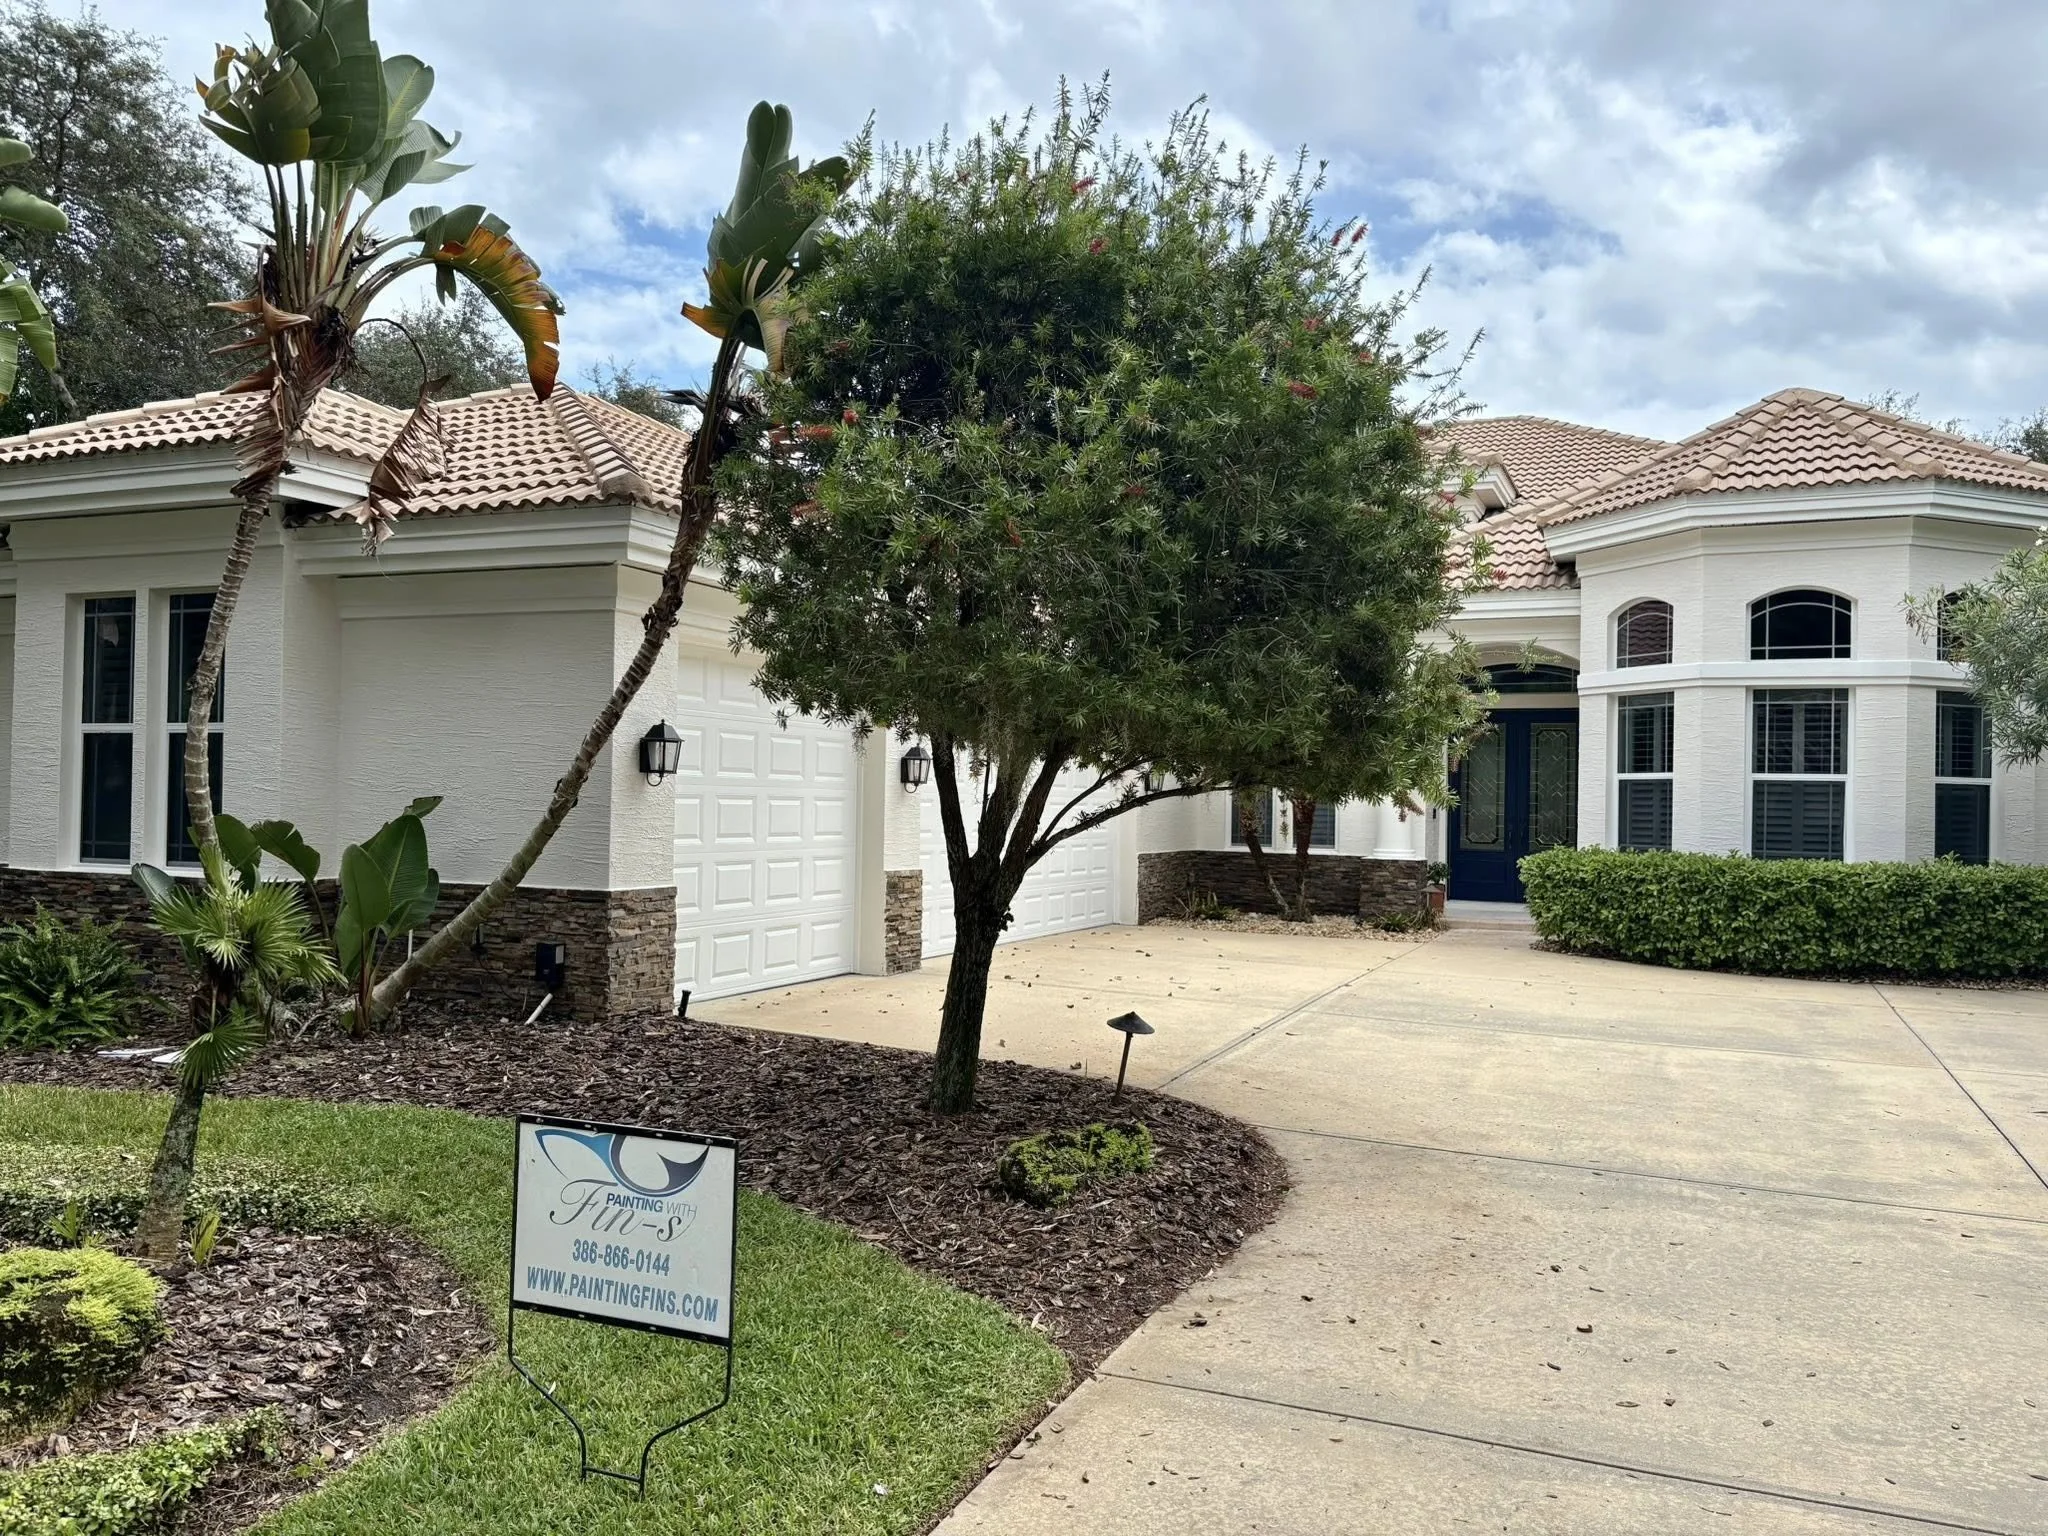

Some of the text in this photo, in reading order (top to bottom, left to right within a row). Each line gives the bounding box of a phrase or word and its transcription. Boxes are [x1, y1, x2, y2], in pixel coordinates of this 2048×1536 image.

[606, 1192, 698, 1218] PAINTING WITH
[572, 1238, 671, 1277] 386-866-0144
[527, 1265, 719, 1323] WWW.PAINTINGFINS.COM
